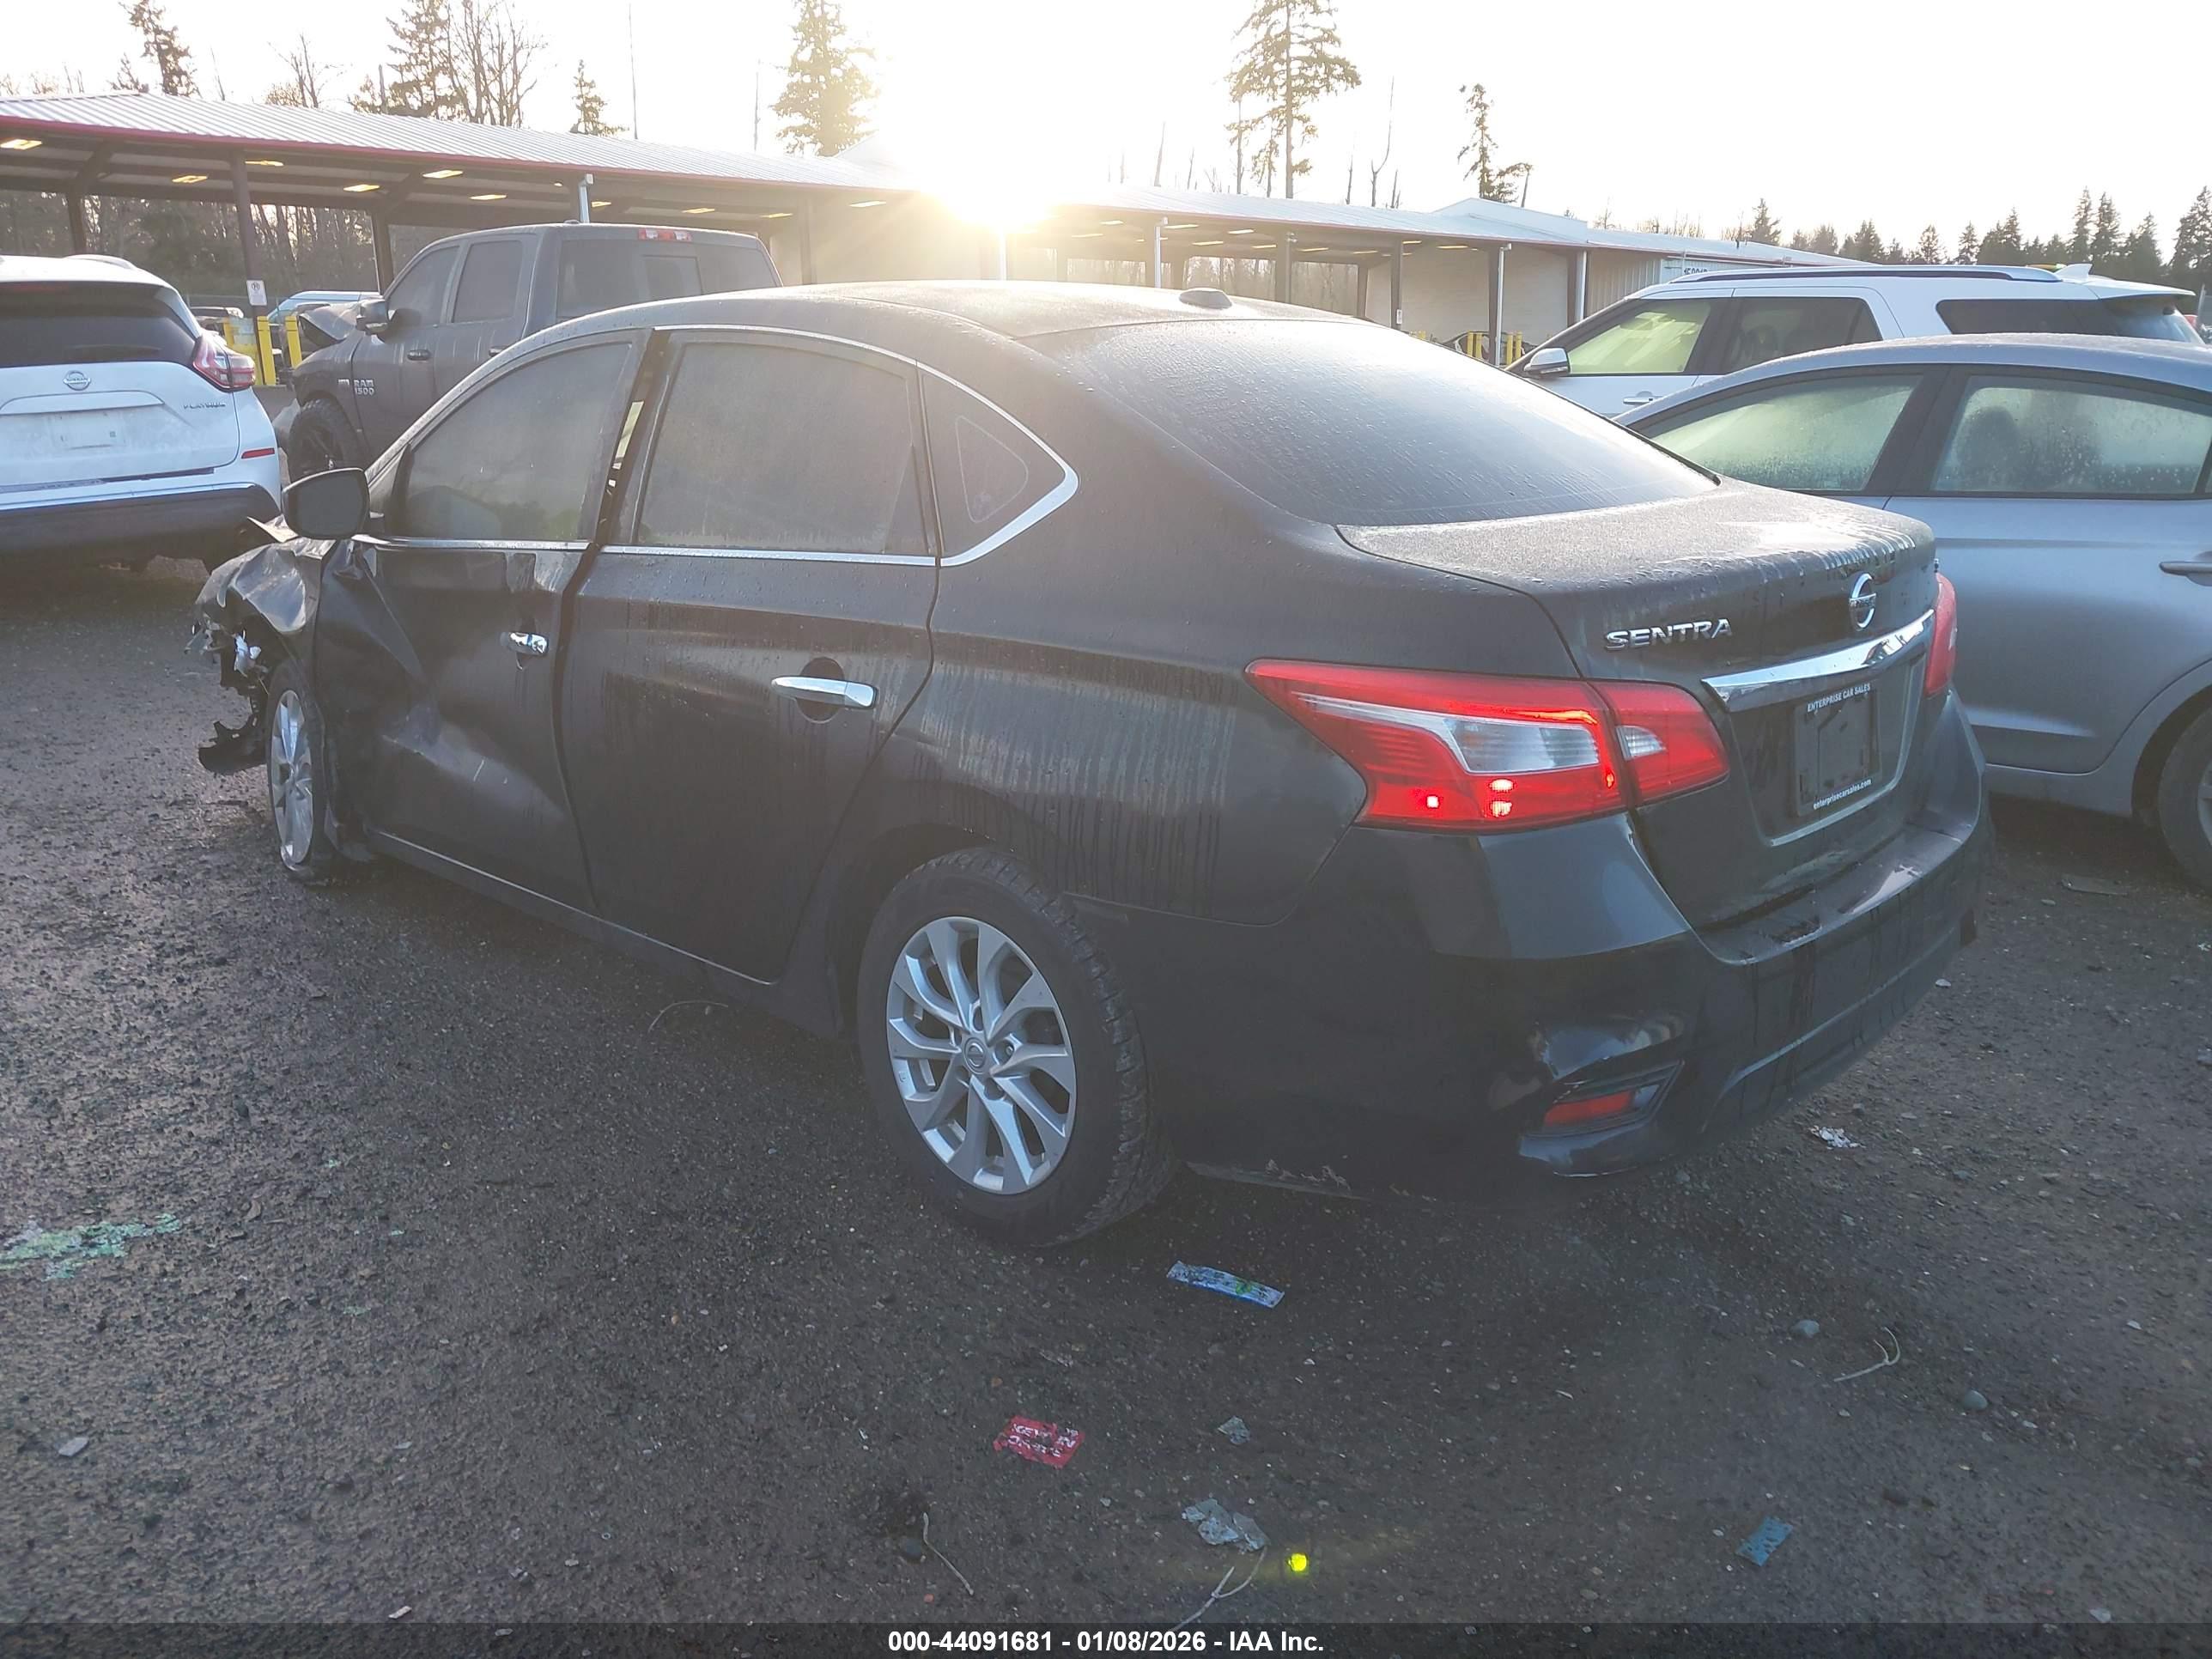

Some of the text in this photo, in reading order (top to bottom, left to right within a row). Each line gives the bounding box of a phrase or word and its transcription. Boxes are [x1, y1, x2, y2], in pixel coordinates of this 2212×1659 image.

[353, 379, 374, 387] RAM
[354, 387, 375, 397] 1500
[1606, 617, 1733, 650] SENTRA
[1807, 683, 1870, 712] ENTERPRISE CAR SALES
[1813, 778, 1873, 810] enterprisecarsales.com
